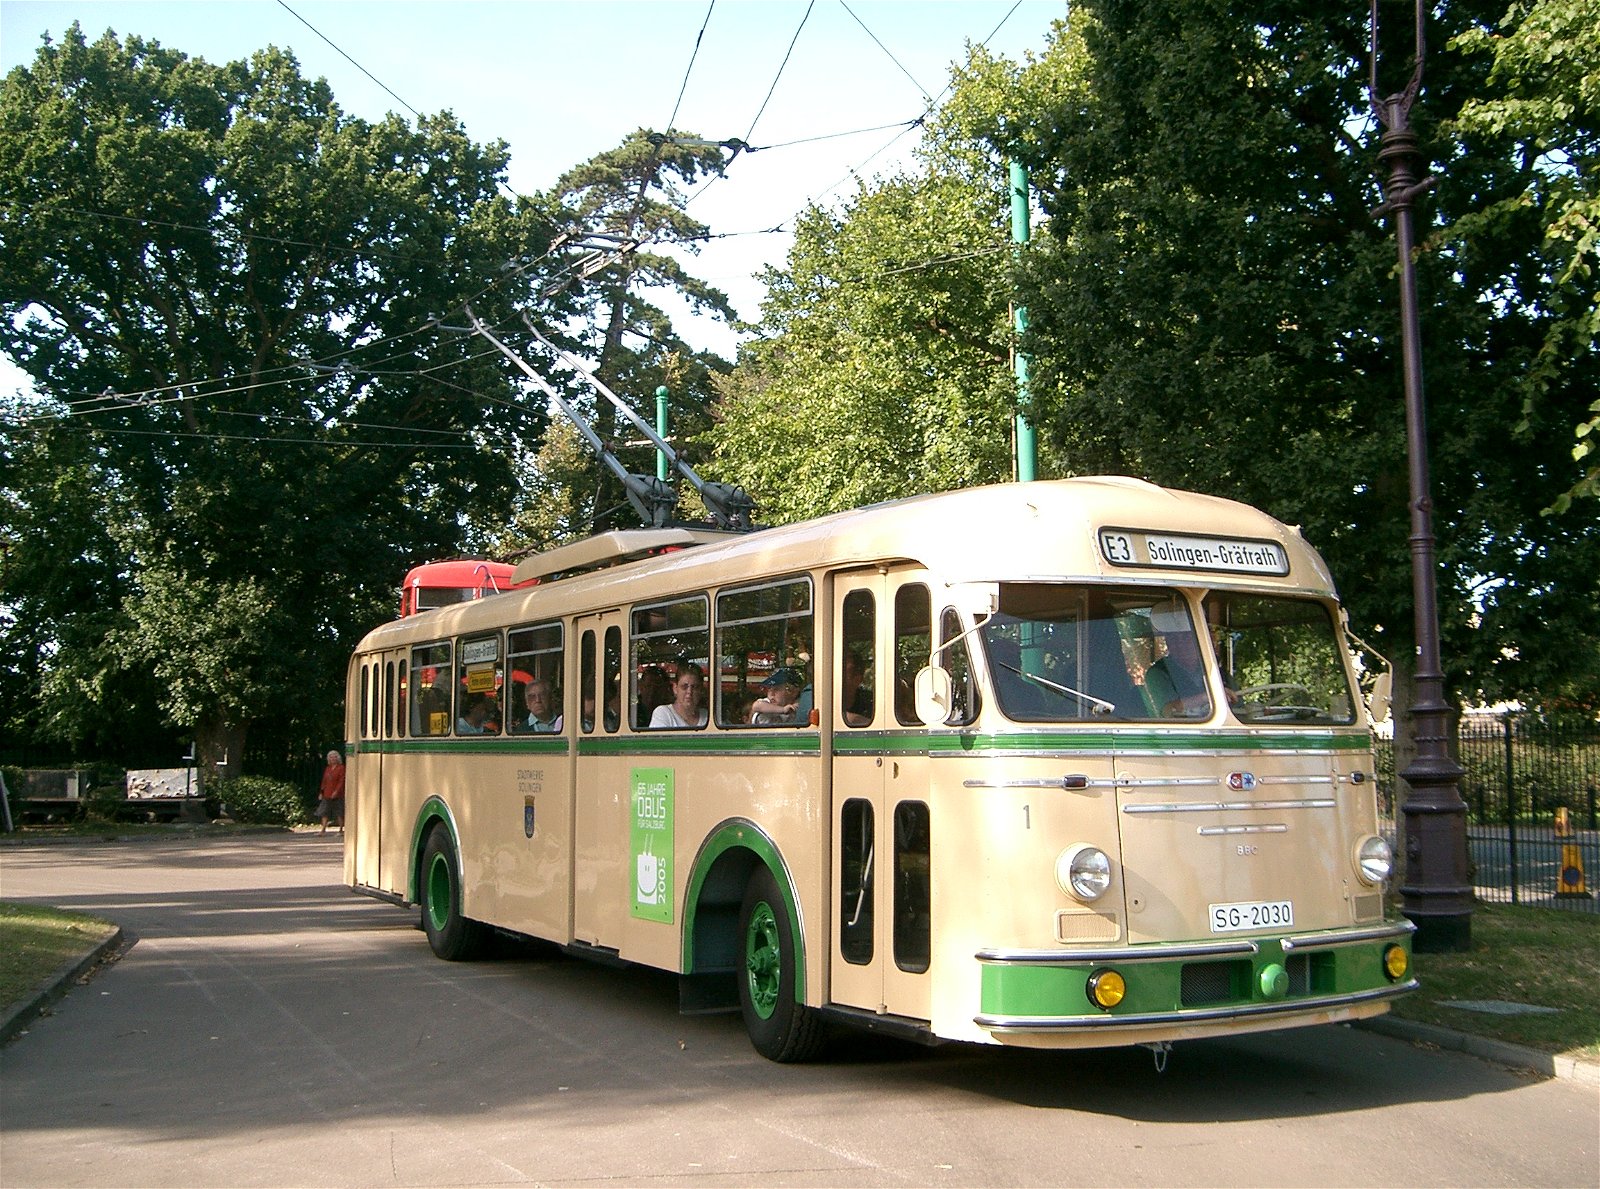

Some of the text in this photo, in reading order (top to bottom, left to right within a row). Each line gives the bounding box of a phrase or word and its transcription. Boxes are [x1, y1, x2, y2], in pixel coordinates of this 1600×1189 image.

[1104, 535, 1131, 561] E3
[1148, 541, 1278, 567] Solingen-Gräfrath
[517, 769, 544, 781] STADTWERKE
[518, 782, 542, 793] SOLINGEN
[647, 783, 666, 796] JAHRE
[637, 796, 666, 818] OBUS
[1023, 804, 1031, 829] 1
[1237, 845, 1258, 856] BBC
[658, 857, 666, 904] 2005
[1215, 904, 1290, 928] SG-2030
